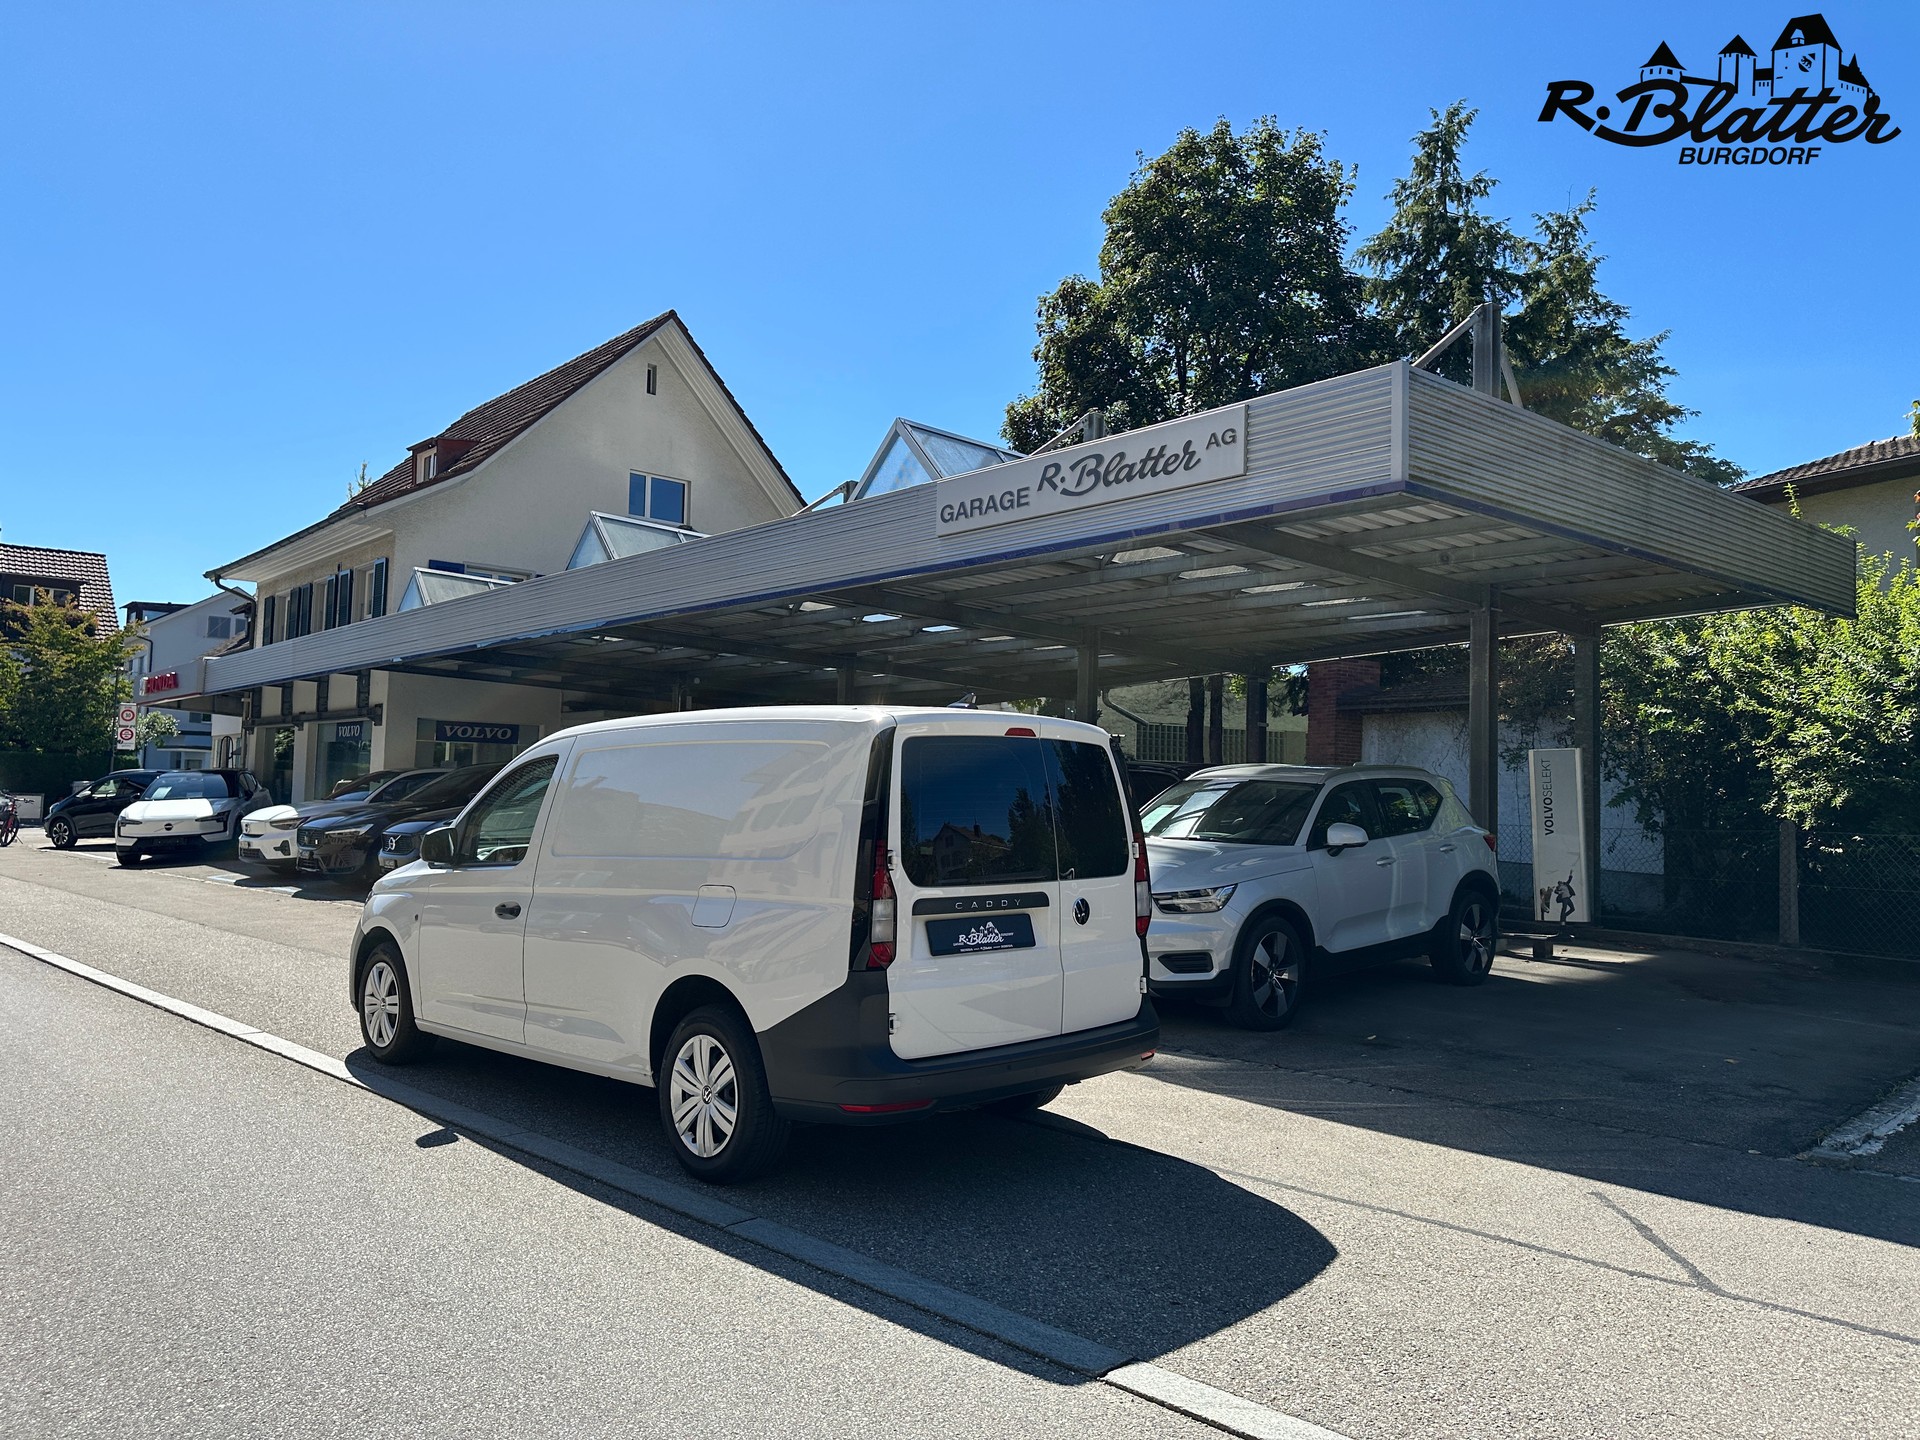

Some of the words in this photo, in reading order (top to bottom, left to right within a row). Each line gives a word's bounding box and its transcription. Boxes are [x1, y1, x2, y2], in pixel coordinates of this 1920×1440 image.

[940, 486, 1030, 523] GARAGE
[1206, 428, 1237, 450] AG
[338, 725, 360, 737] VOLVO
[444, 725, 512, 740] VOLVO
[955, 899, 1021, 910] CADDY
